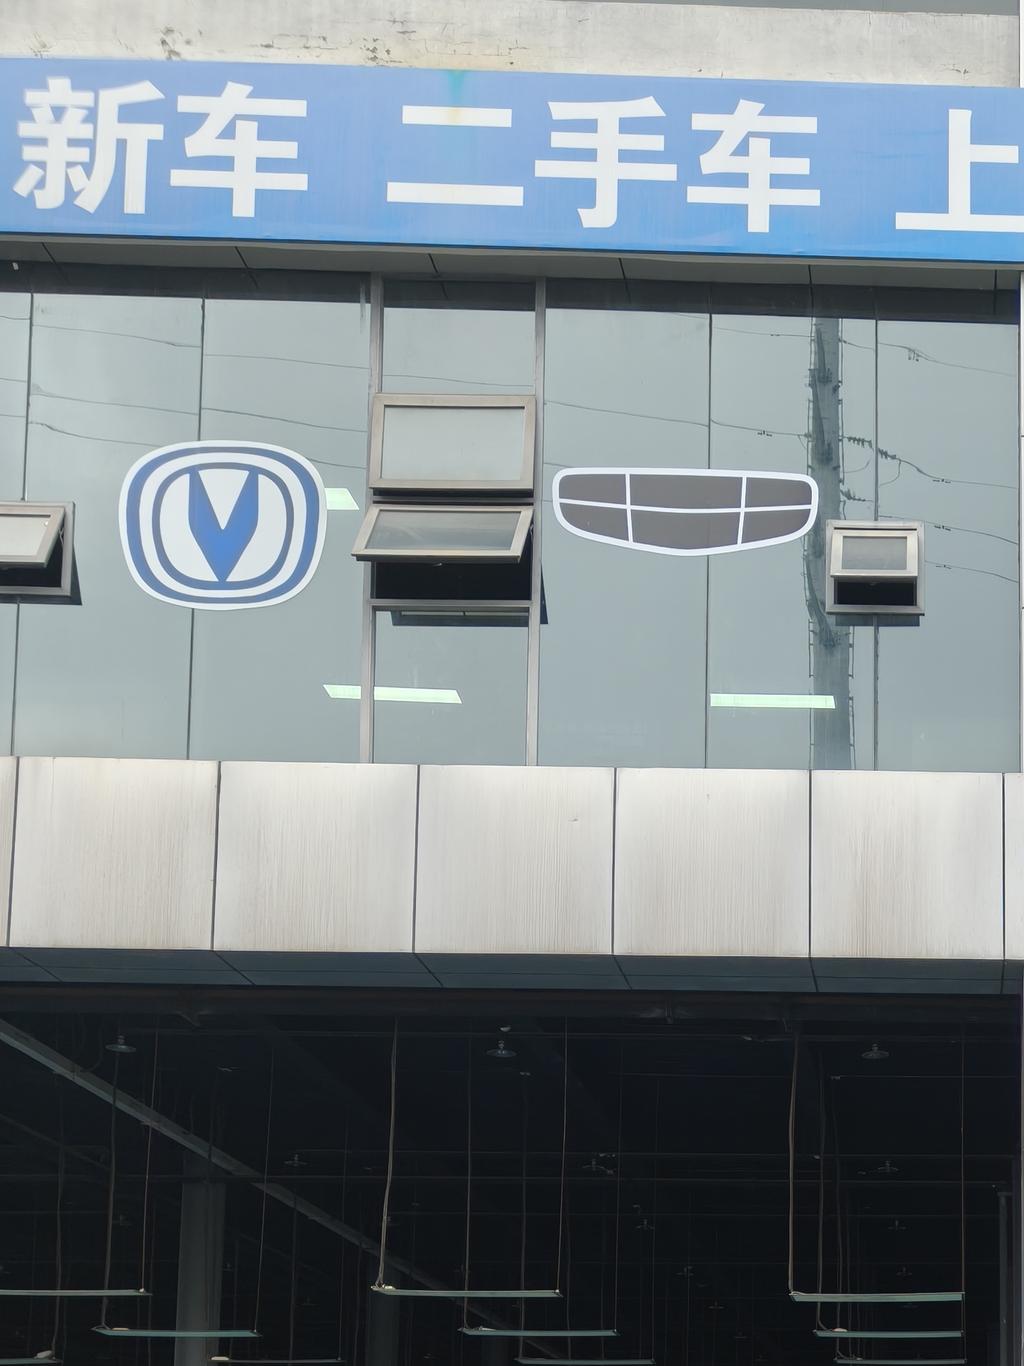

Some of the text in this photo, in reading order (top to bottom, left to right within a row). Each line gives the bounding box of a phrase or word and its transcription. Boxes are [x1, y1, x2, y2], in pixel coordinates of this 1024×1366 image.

[14, 76, 309, 218] 新车
[386, 94, 822, 233] 二手车
